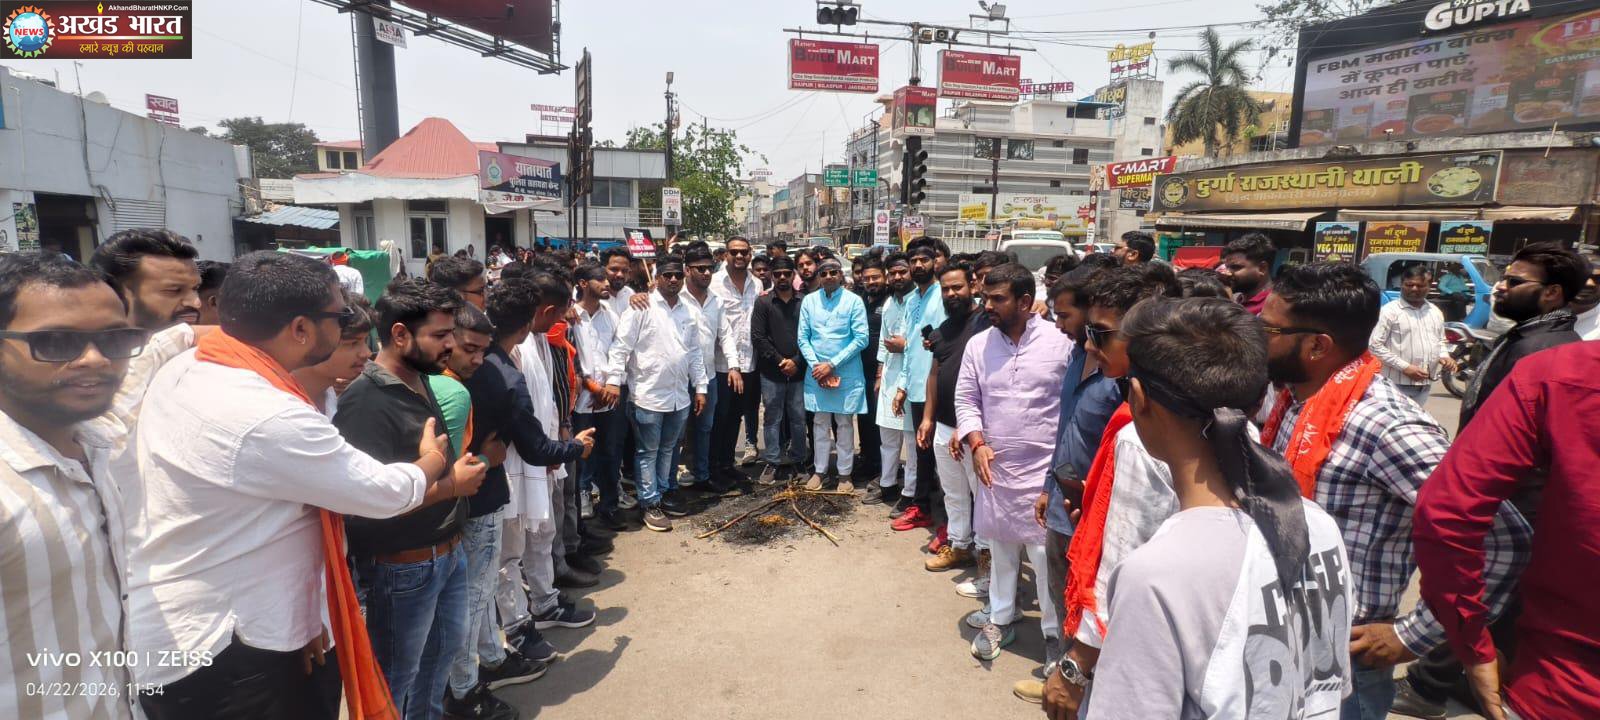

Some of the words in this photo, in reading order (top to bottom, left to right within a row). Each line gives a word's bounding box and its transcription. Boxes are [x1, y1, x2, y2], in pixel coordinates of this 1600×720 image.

[1425, 0, 1531, 30] GUPTA
[1317, 58, 1360, 73] FBM
[1365, 41, 1443, 63] मसाला
[1446, 29, 1516, 50] बॉक्स
[1339, 89, 1380, 100] आज
[1386, 80, 1408, 95] ही
[1413, 67, 1478, 88] खरीदें
[1341, 70, 1360, 84] में
[1364, 62, 1420, 84] कूपन
[515, 162, 552, 179] यातायात
[1111, 158, 1170, 175] C-MART
[1196, 172, 1237, 198] दुर्गा
[1240, 166, 1348, 192] राजस्थानी
[1352, 161, 1424, 185] थाली
[1316, 243, 1331, 253] VEG
[1333, 243, 1354, 253] THALI
